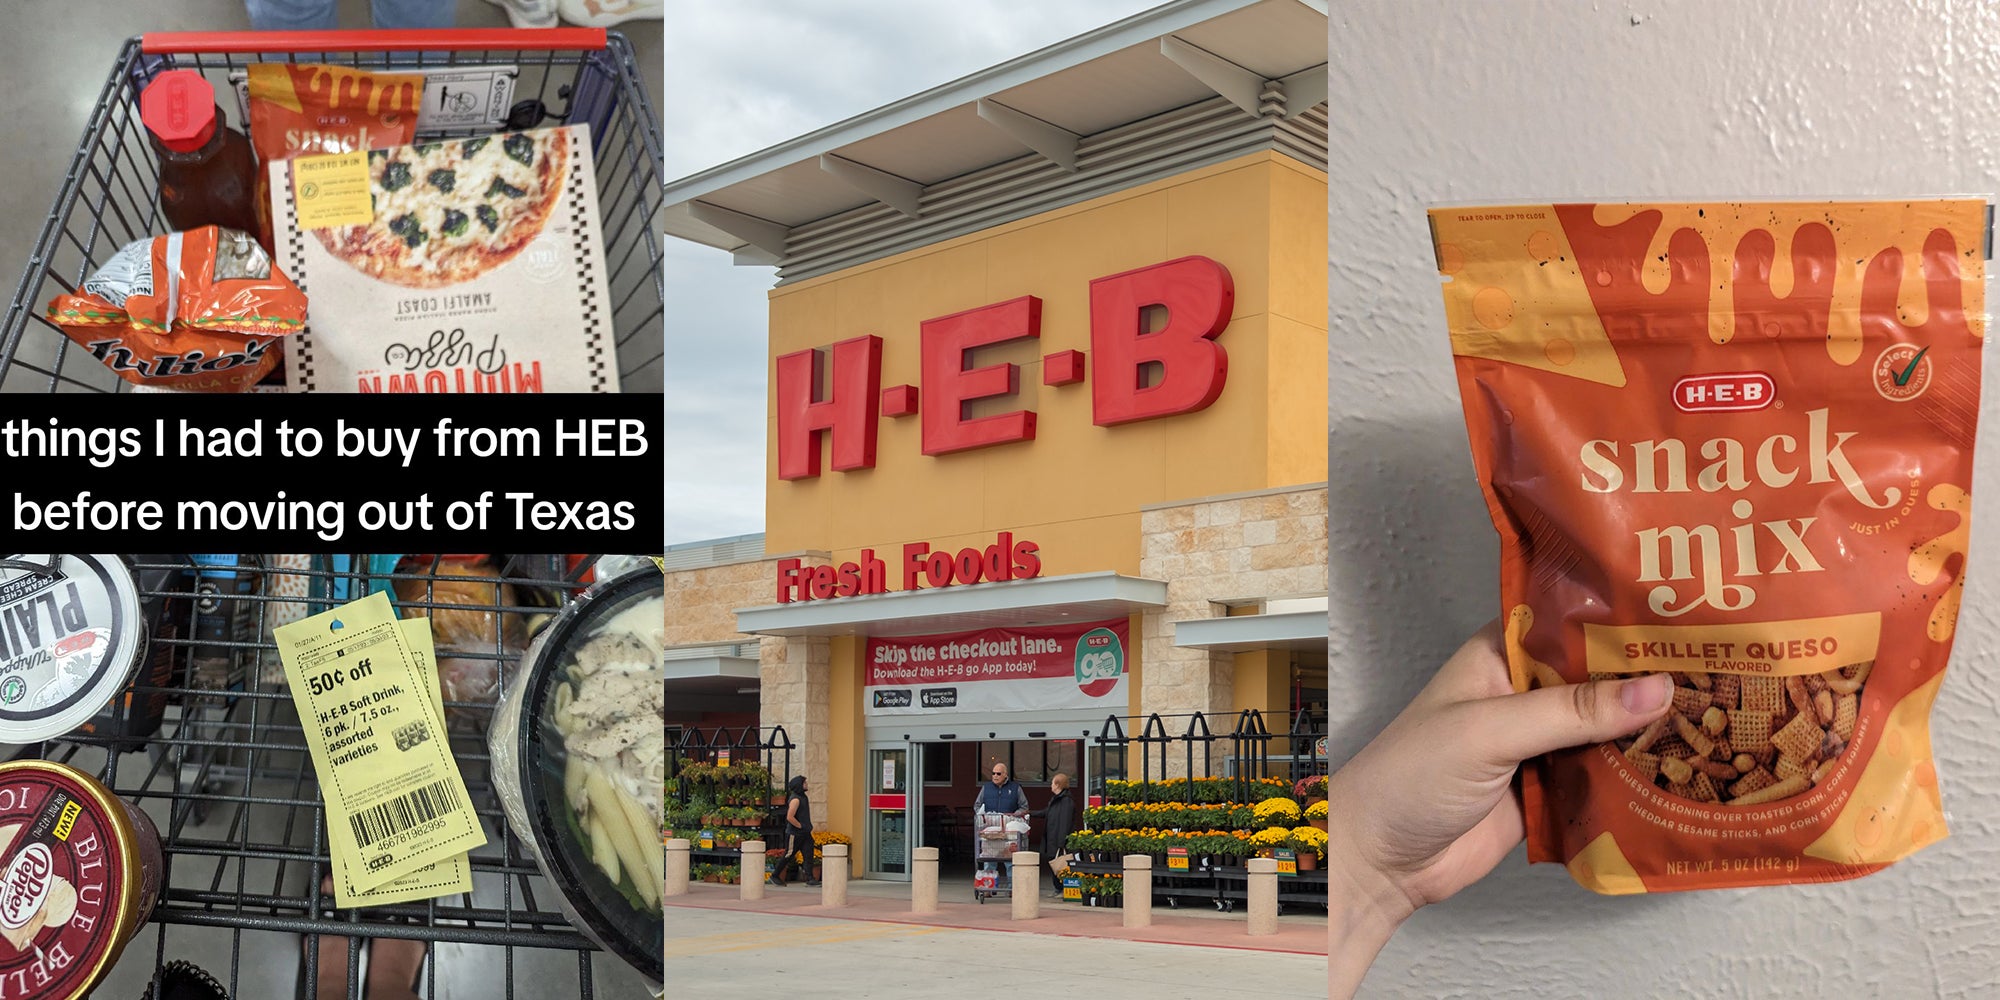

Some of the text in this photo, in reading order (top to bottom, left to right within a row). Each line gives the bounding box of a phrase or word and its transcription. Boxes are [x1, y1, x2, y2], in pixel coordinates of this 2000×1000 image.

[397, 293, 492, 314] AMALFI COAST
[385, 329, 506, 375] Pizza
[776, 254, 1235, 481] H-E-B
[1879, 351, 1914, 376] Select
[1686, 383, 1762, 403] H-E-B
[1881, 369, 1925, 395] Ingredients
[1580, 408, 1901, 509] snack
[1849, 468, 1920, 535] JUST IN QUESO
[777, 531, 1041, 603] Fresh Foods
[1635, 499, 1825, 617] mix
[4, 575, 37, 593] SPREAD
[25, 576, 53, 594] CREAM
[874, 636, 1062, 666] Skip the checkout lane.
[1625, 637, 1838, 660] SKILLET QUESO
[309, 658, 373, 696] 50¢ off
[874, 660, 1036, 679] Download the H-E-B go App today!
[1078, 651, 1116, 685] go
[1705, 660, 1772, 673] FLAVORED
[320, 685, 405, 724] H-E-B Soft Drink,
[883, 697, 910, 705] Google Play
[930, 697, 939, 705] App
[325, 727, 332, 737] 6
[333, 722, 350, 737] pk.
[360, 708, 379, 723] 7.5
[329, 726, 374, 752] assorted
[333, 743, 379, 766] varieties
[1619, 769, 1649, 797] QUESO
[1651, 795, 1710, 820] SEASONING
[1714, 812, 1742, 822] OVER
[1746, 805, 1793, 821] TOASTED
[1796, 792, 1826, 810] CORN,
[1827, 766, 1848, 792] CORN
[57, 805, 77, 837] NEW!
[1629, 790, 1848, 839] CHEDDAR SESAME STICKS, AND CORN STICKS
[377, 818, 447, 852] 466781982995
[1667, 862, 1689, 875] NET
[1696, 861, 1717, 873] WT.
[1722, 859, 1729, 872] 5
[1735, 859, 1749, 871] OZ
[1754, 857, 1781, 871] (142
[12, 848, 49, 919] Pepper
[24, 873, 45, 907] Dr
[72, 832, 103, 933] BLUE
